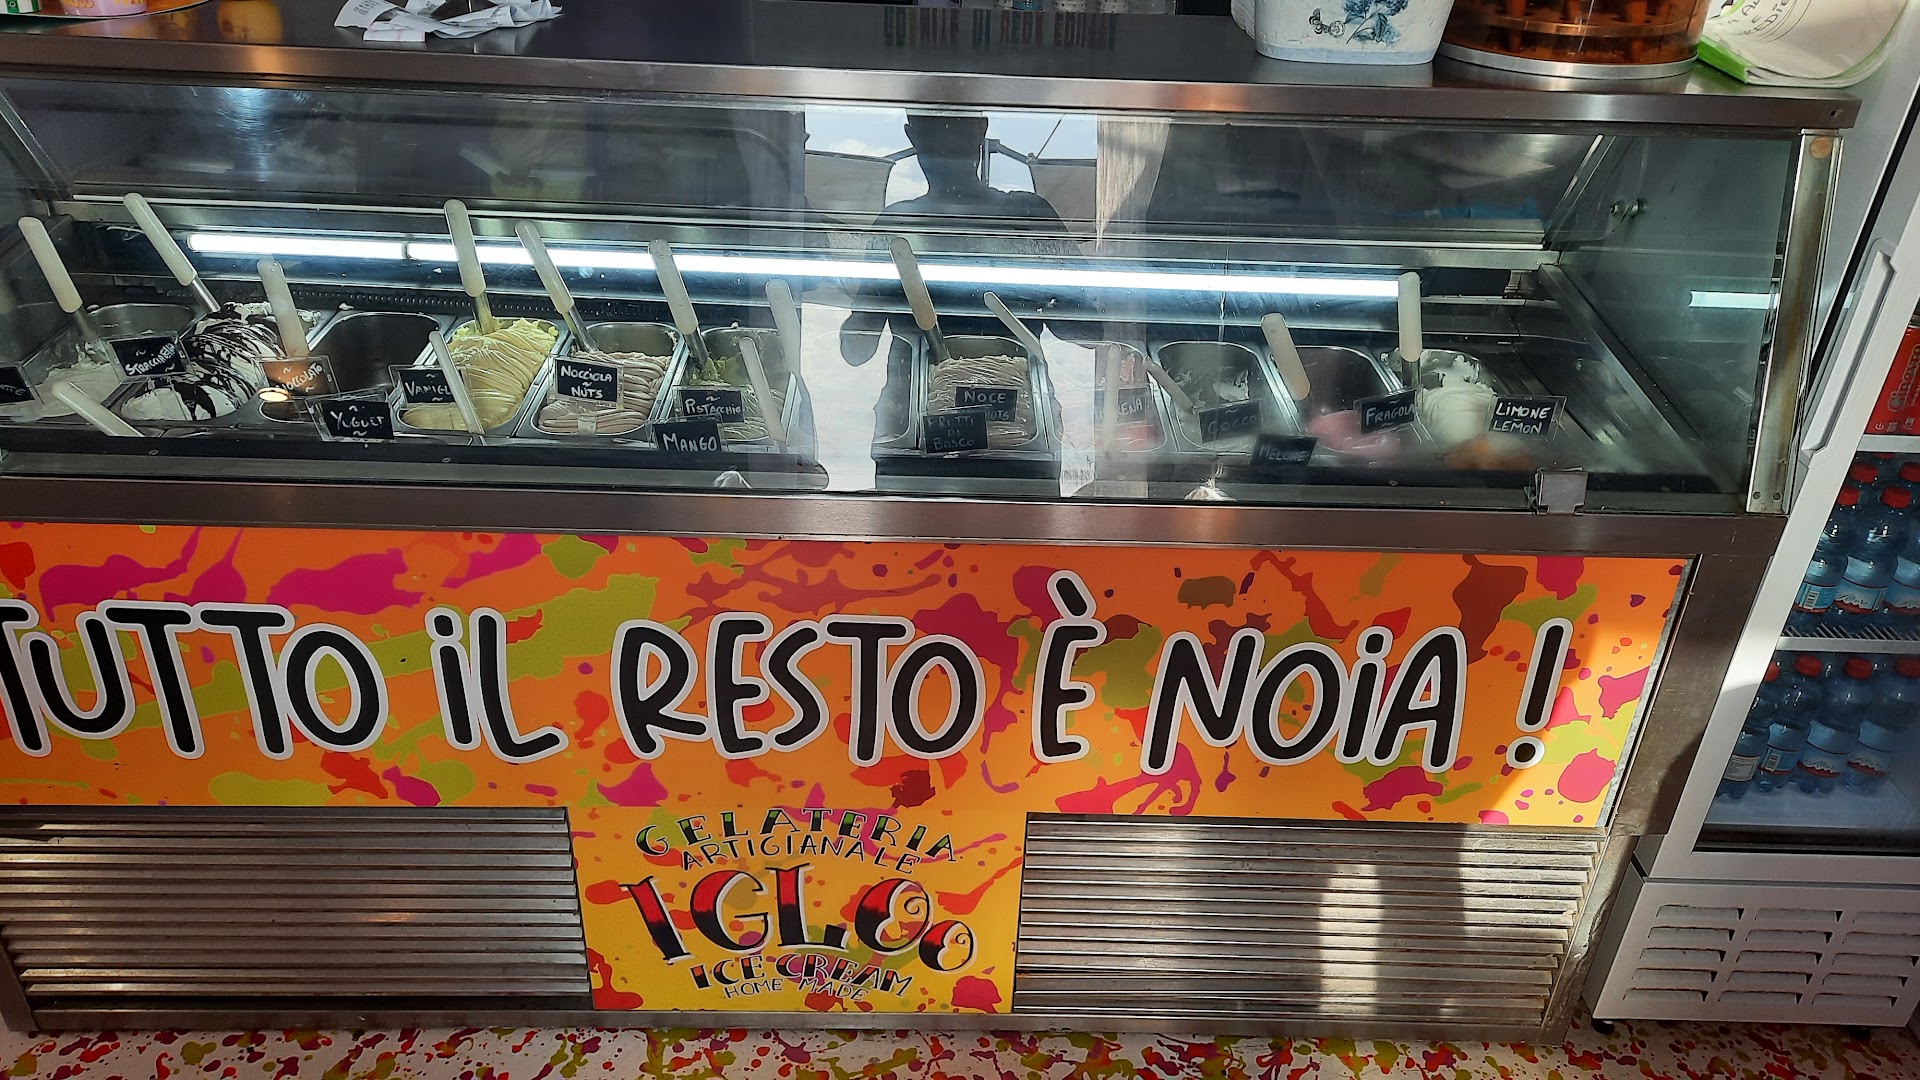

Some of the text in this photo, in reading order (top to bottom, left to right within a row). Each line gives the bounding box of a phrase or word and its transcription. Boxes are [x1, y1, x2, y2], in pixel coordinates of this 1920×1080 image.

[275, 362, 323, 391] IOCCOLATO
[405, 381, 452, 397] VANIGL
[571, 386, 603, 399] NUTS
[964, 390, 1006, 404] NOCE
[1119, 396, 1143, 416] ENA
[1366, 403, 1416, 426] FRAGOLA
[1493, 419, 1542, 434] LEMON
[662, 433, 718, 452] MANGO
[933, 437, 975, 450] BOSCO
[1259, 444, 1307, 462] MELONE
[0, 598, 388, 760] TUTTO
[610, 612, 986, 766] RESTO
[1032, 570, 1107, 763] È
[634, 807, 958, 862] GELATERIA
[682, 834, 922, 875] ARTIGIANALE
[688, 952, 914, 998] ICE CREAM
[723, 977, 871, 1002] HOME MADE
